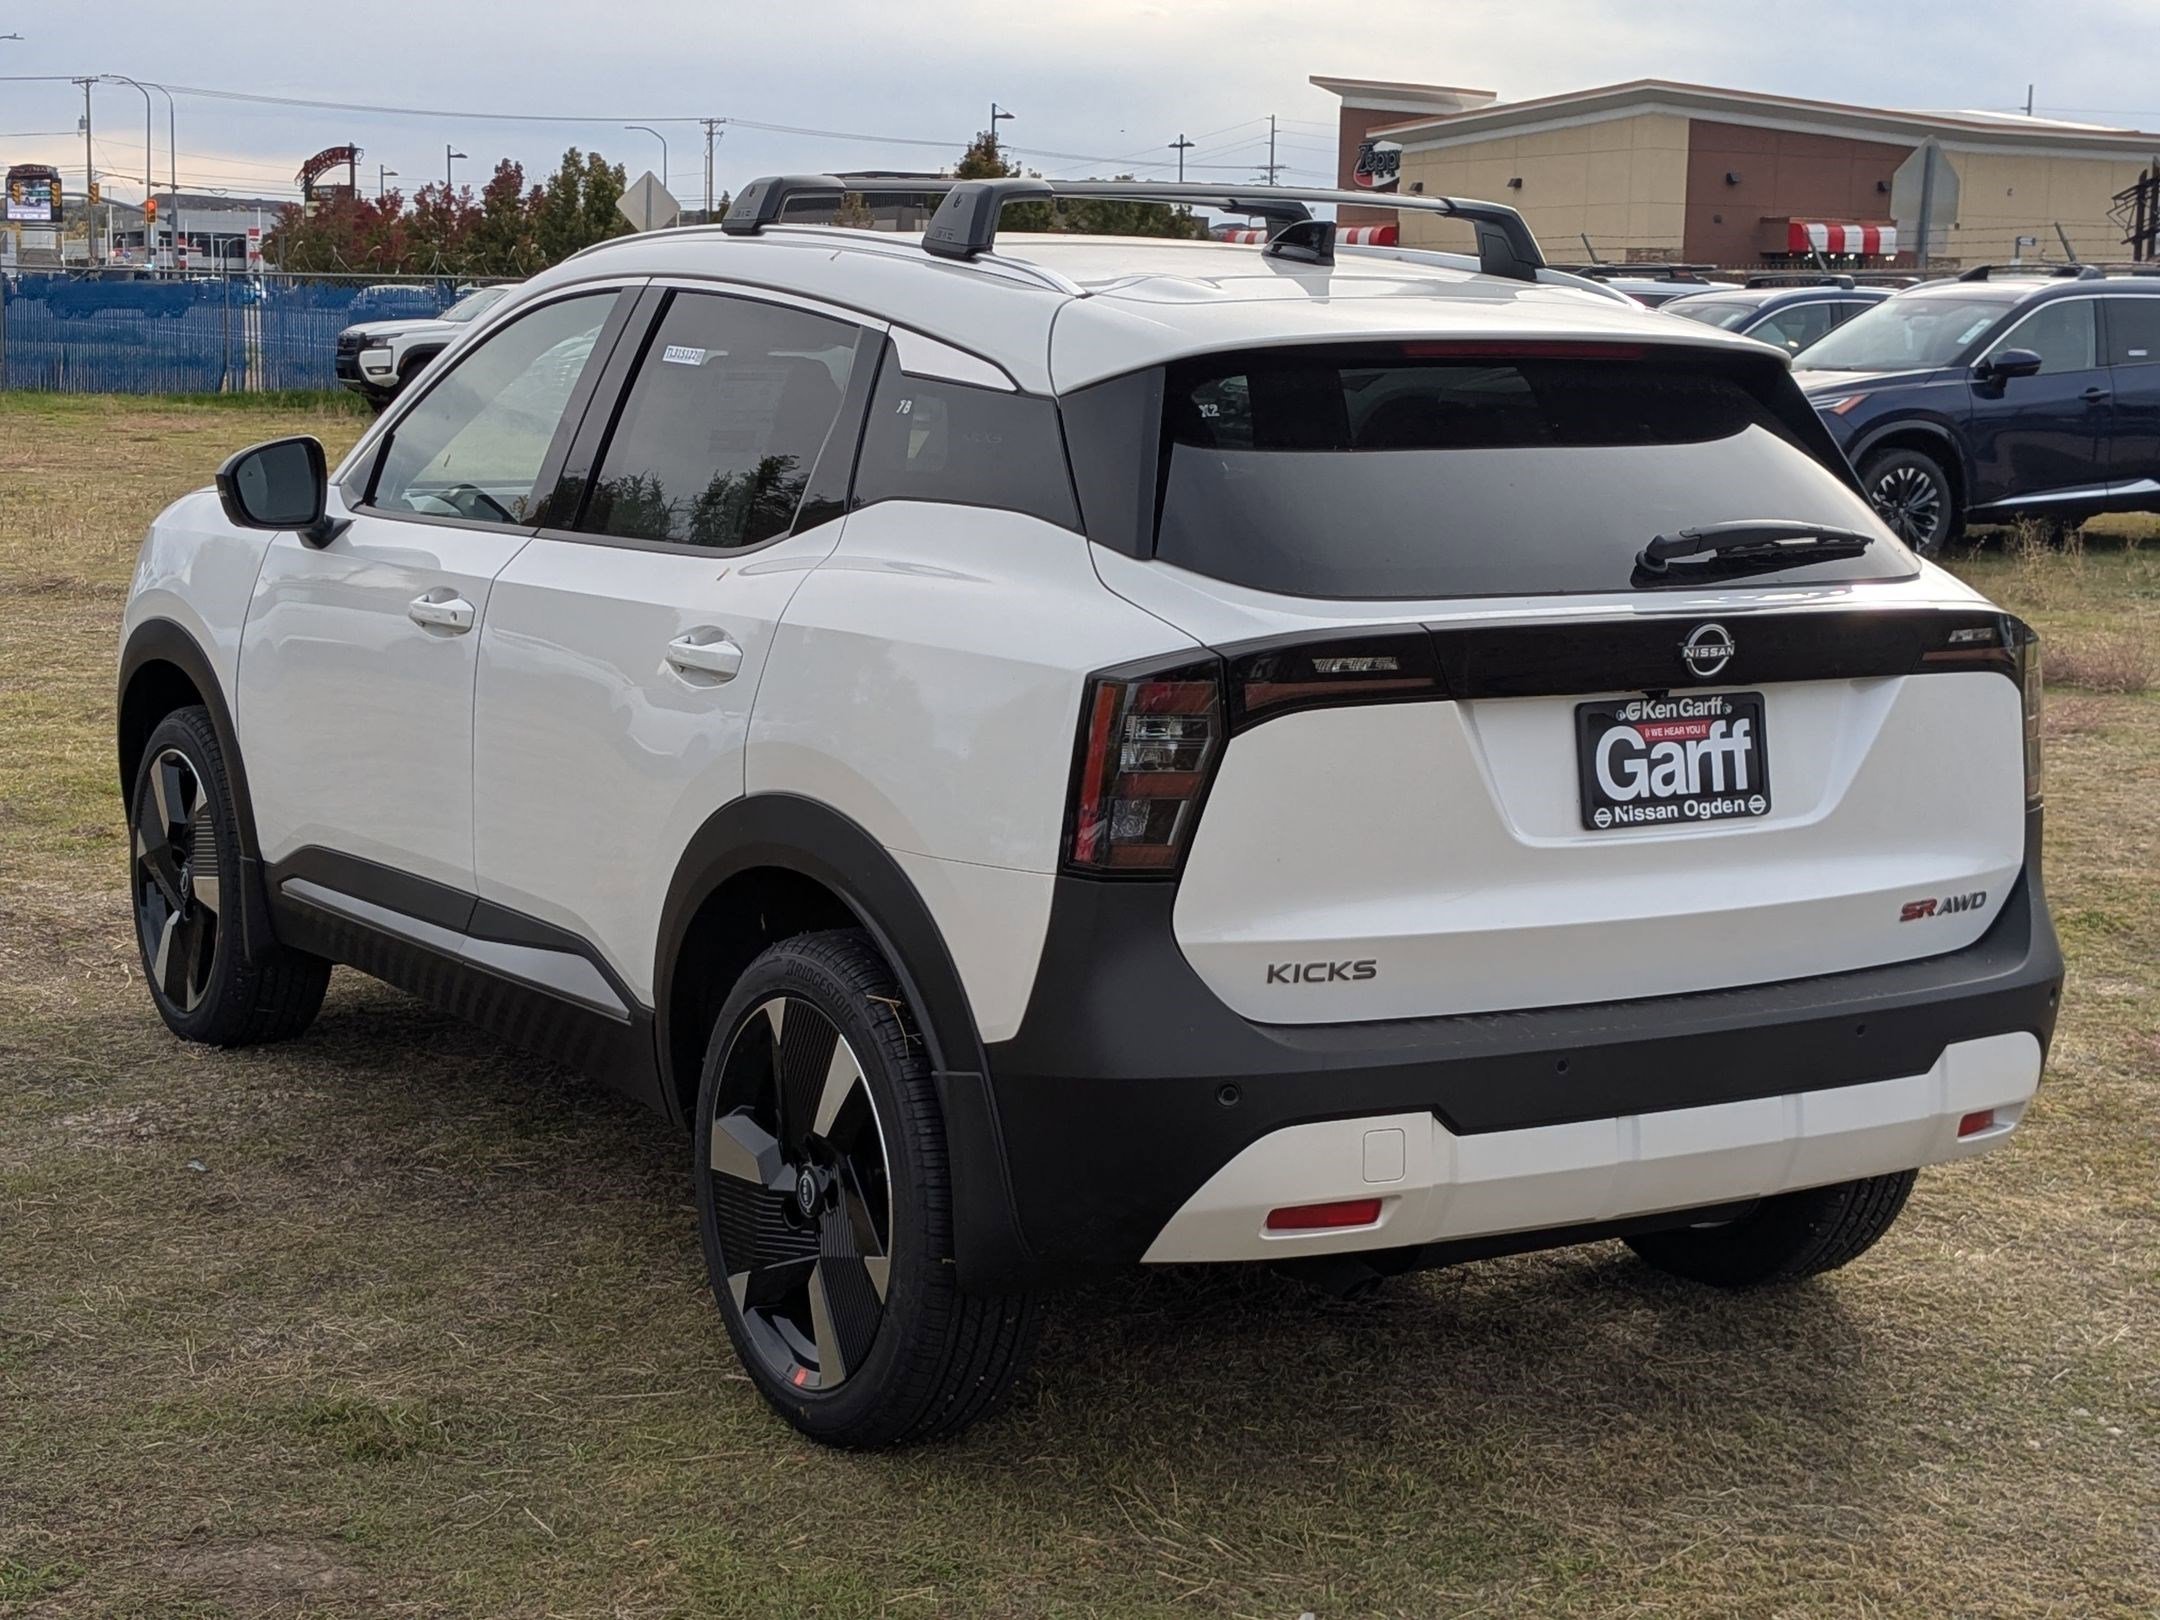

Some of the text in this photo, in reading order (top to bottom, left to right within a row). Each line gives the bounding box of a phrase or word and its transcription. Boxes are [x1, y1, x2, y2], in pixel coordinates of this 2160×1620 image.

[1682, 645, 1735, 658] NISSAN
[1641, 697, 1723, 720] Ken Garff
[1651, 724, 1701, 737] WE HEAR YOU
[1595, 718, 1752, 801] Garff
[1614, 798, 1746, 823] Nissan Ogden
[1899, 891, 1987, 922] SR AWD
[1266, 959, 1377, 984] KICKS
[785, 959, 858, 1024] BRIDGESTONE
